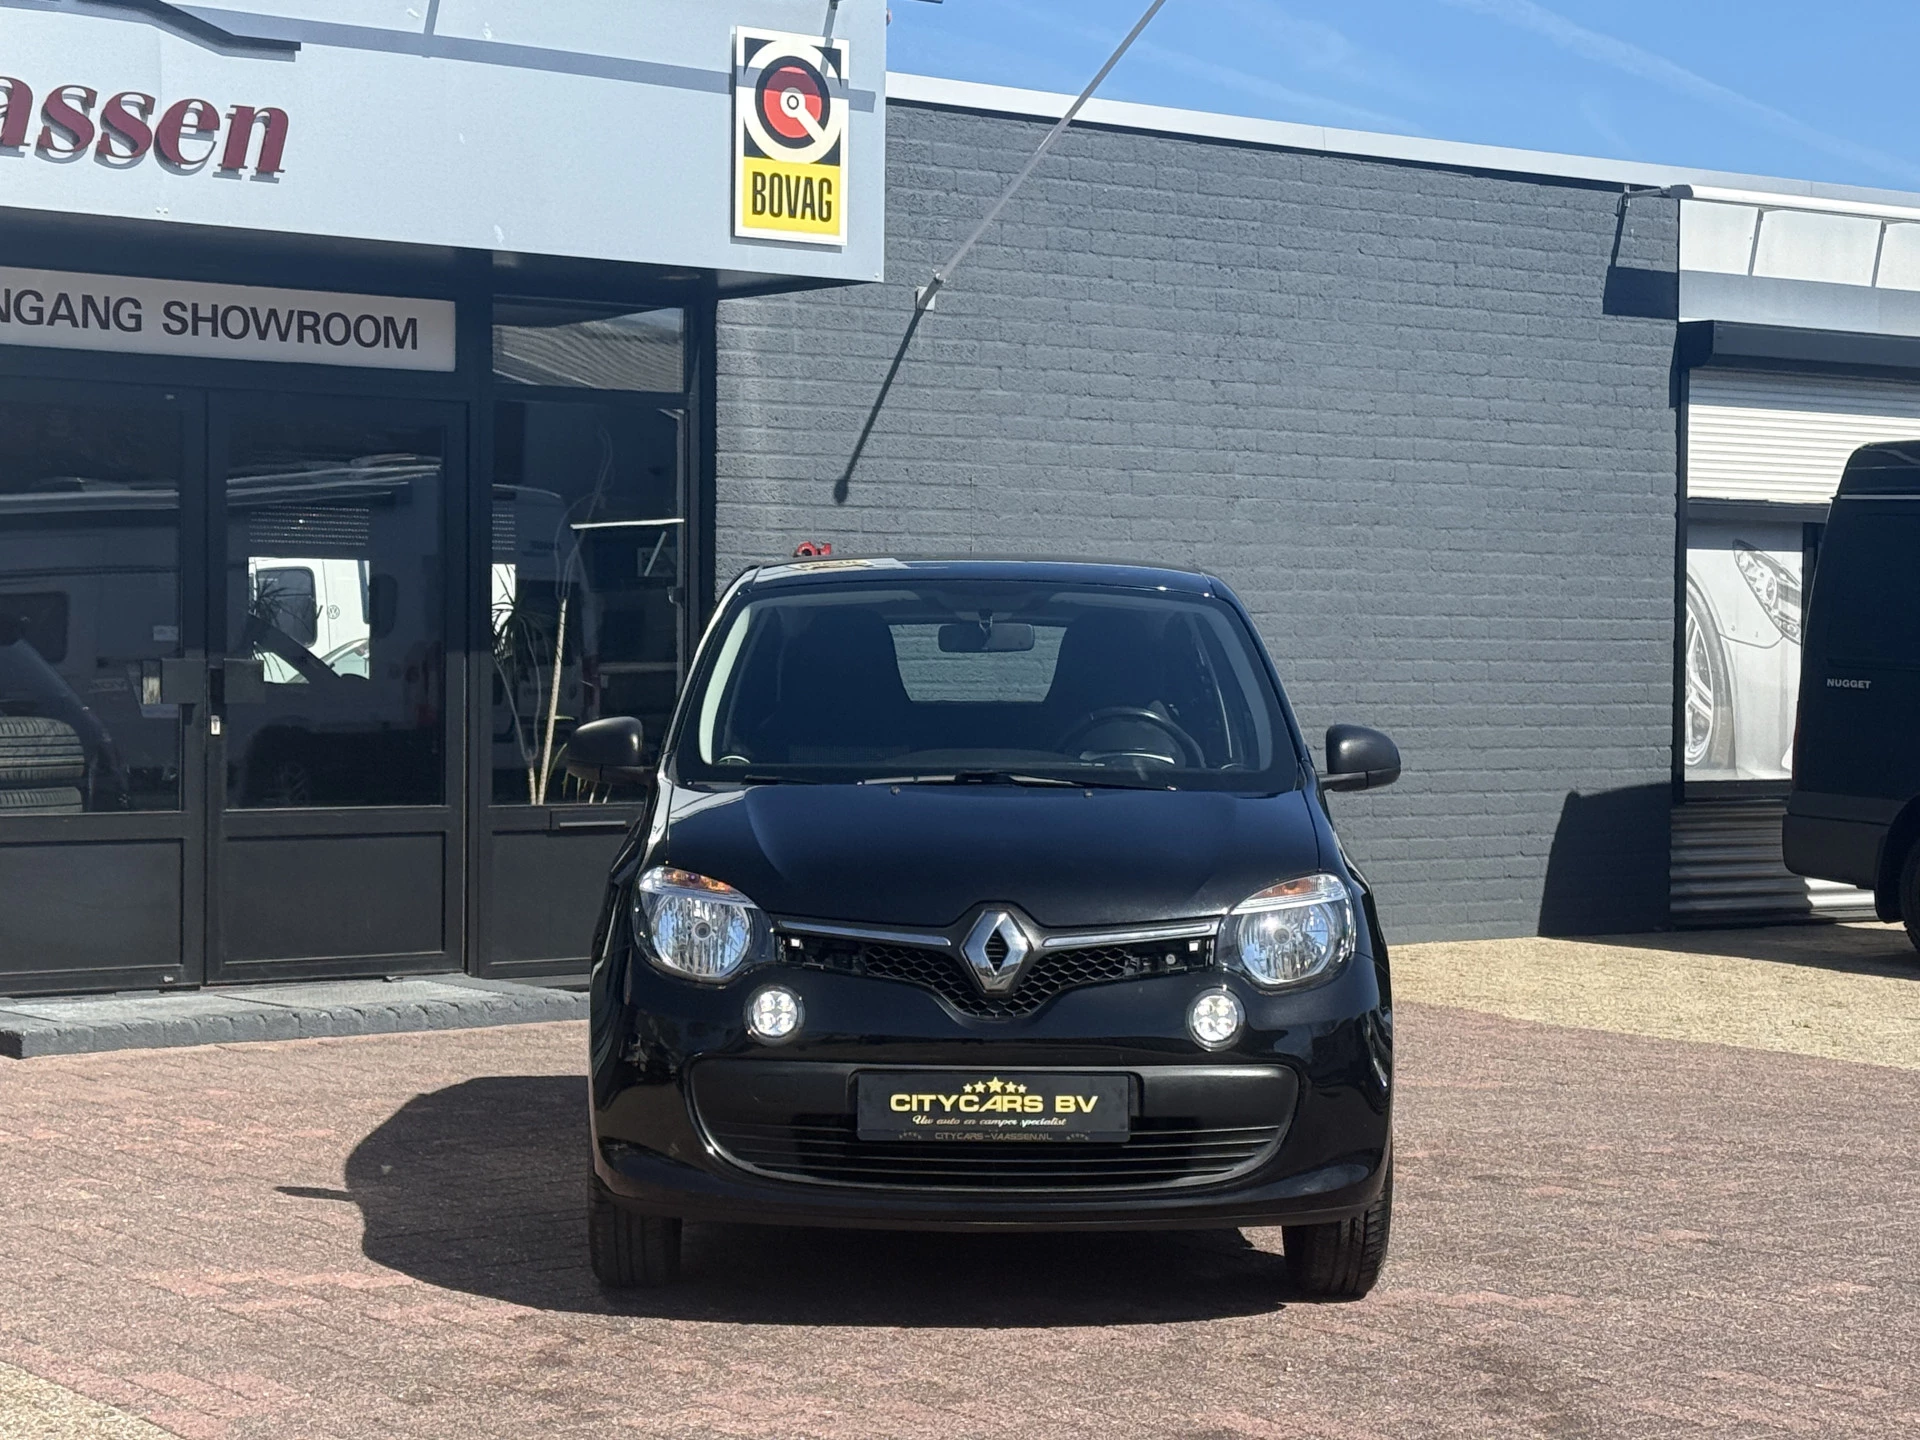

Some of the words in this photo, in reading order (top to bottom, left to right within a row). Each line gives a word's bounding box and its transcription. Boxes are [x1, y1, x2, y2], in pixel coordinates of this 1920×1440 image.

[751, 171, 833, 223] BOVAG
[162, 300, 418, 351] SHOWROOM
[1826, 678, 1872, 689] NUGGET
[890, 1093, 1044, 1112] CITYCARS
[1055, 1095, 1098, 1113] BV
[936, 1117, 960, 1125] auto
[979, 1118, 1018, 1128] camper
[1020, 1116, 1067, 1128] specialist
